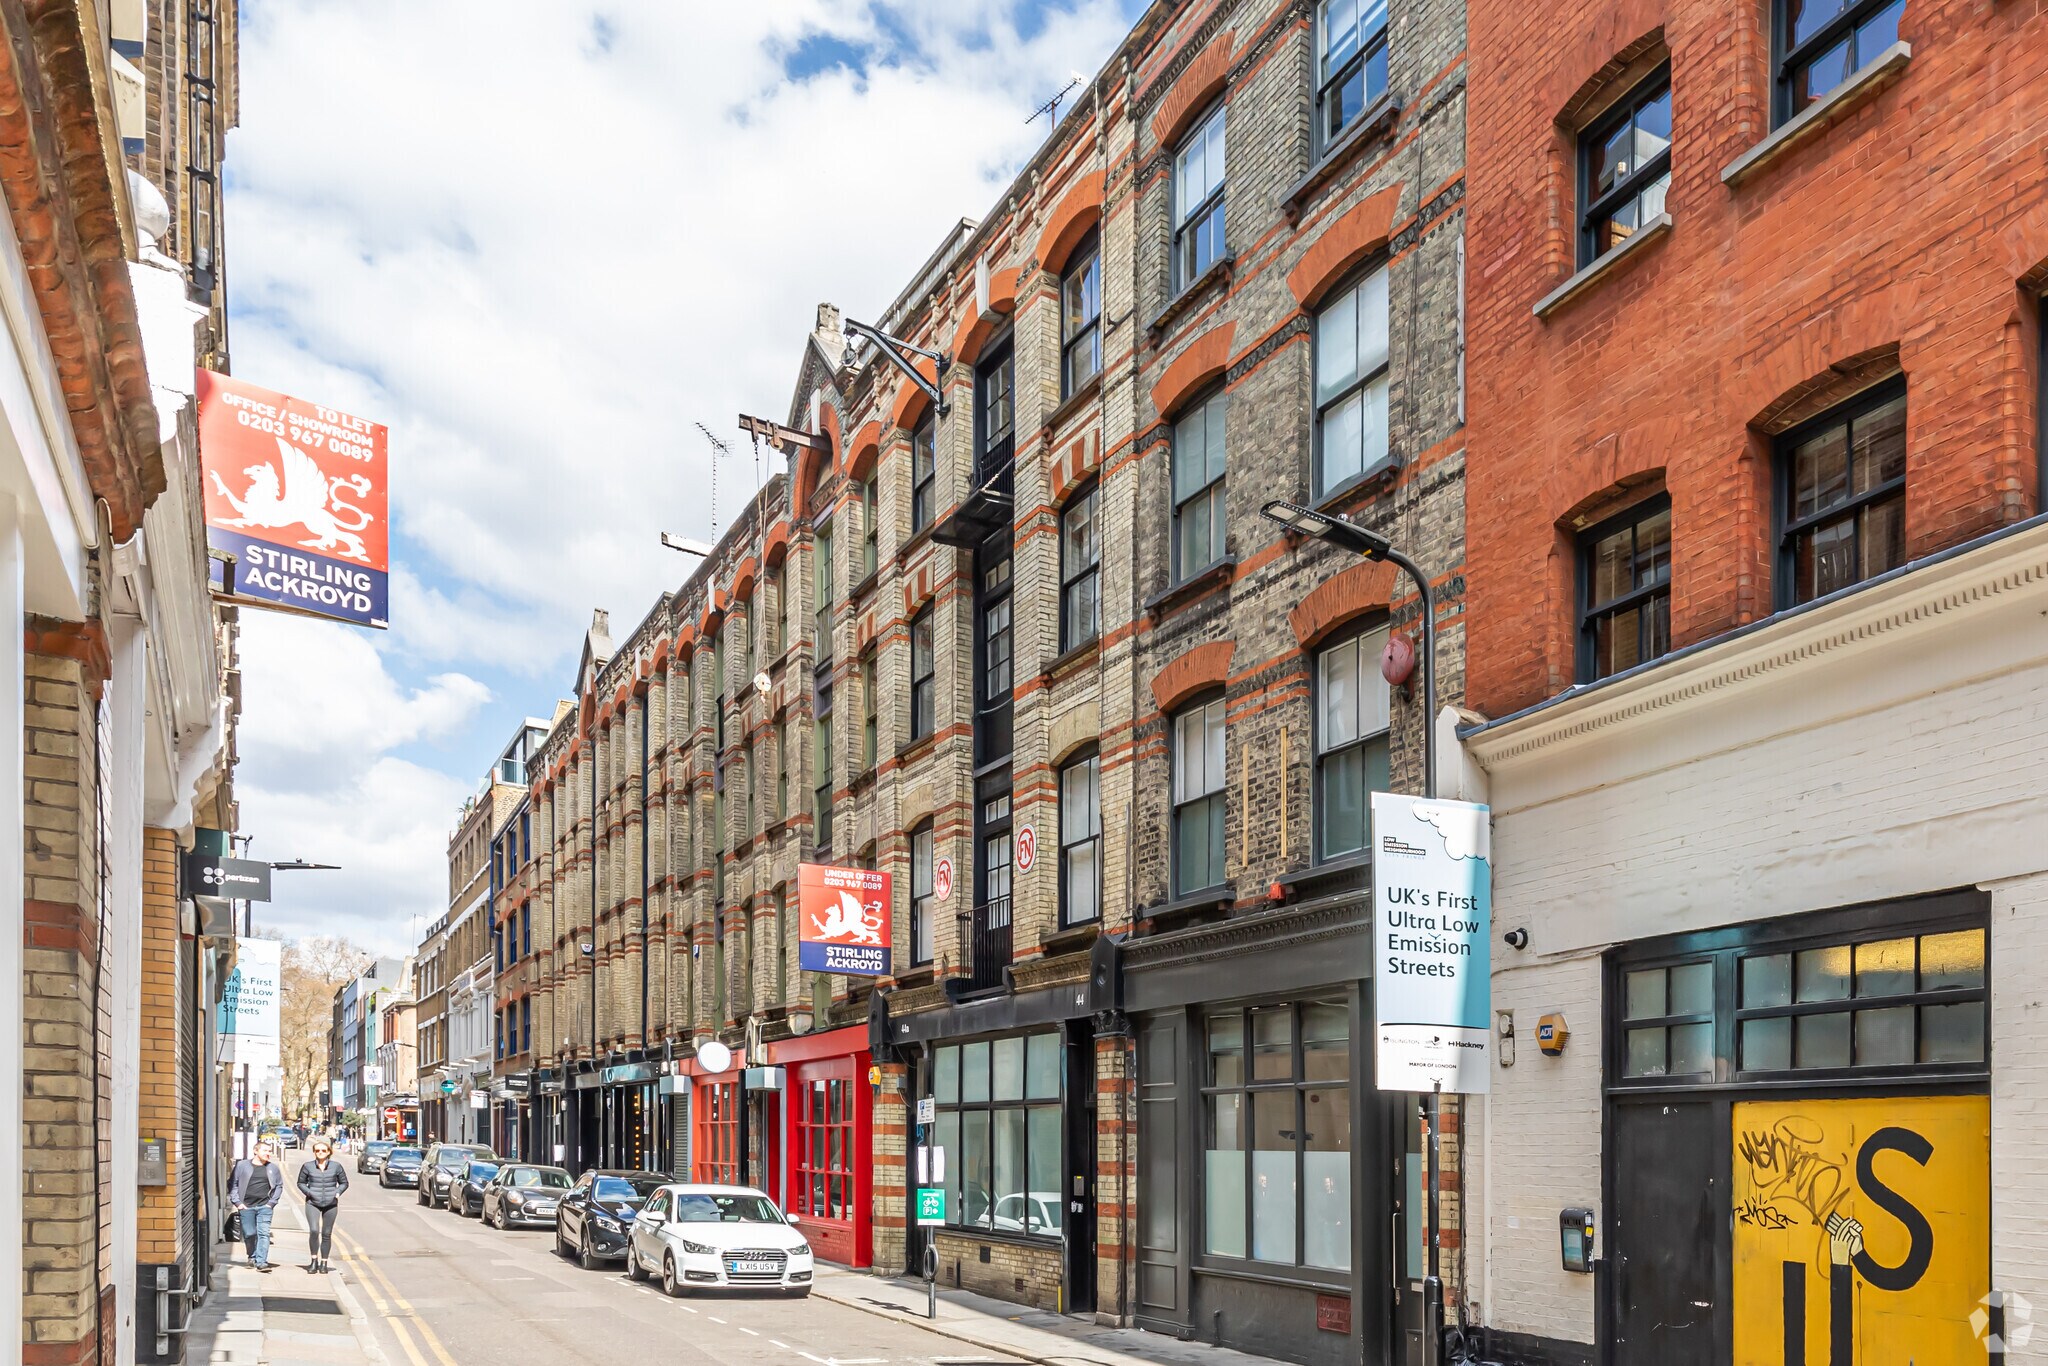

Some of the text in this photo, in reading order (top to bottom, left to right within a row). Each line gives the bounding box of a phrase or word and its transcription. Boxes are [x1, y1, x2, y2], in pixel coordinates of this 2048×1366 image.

[221, 391, 276, 419] OFFICE
[288, 412, 373, 448] SHOWROOM
[314, 405, 373, 434] TO LET
[237, 410, 373, 463] 0203 967 0089
[245, 544, 372, 592] STIRLING
[245, 566, 372, 613] ACKROYD
[824, 869, 883, 883] UNDER OFFER
[824, 877, 883, 891] 0203 967 0089
[1387, 886, 1478, 911] UK's First
[1387, 910, 1479, 934] Ultra Low
[1388, 934, 1471, 956] Emission
[826, 946, 883, 961] STIRLING
[826, 957, 883, 971] ACKROYD
[1387, 957, 1455, 978] Streets
[250, 977, 273, 987] First
[224, 984, 274, 997] Ultra Low
[223, 994, 269, 1006] Emission
[223, 1003, 260, 1015] Streets
[1540, 1027, 1553, 1037] ADT
[1455, 1040, 1485, 1050] Hackney
